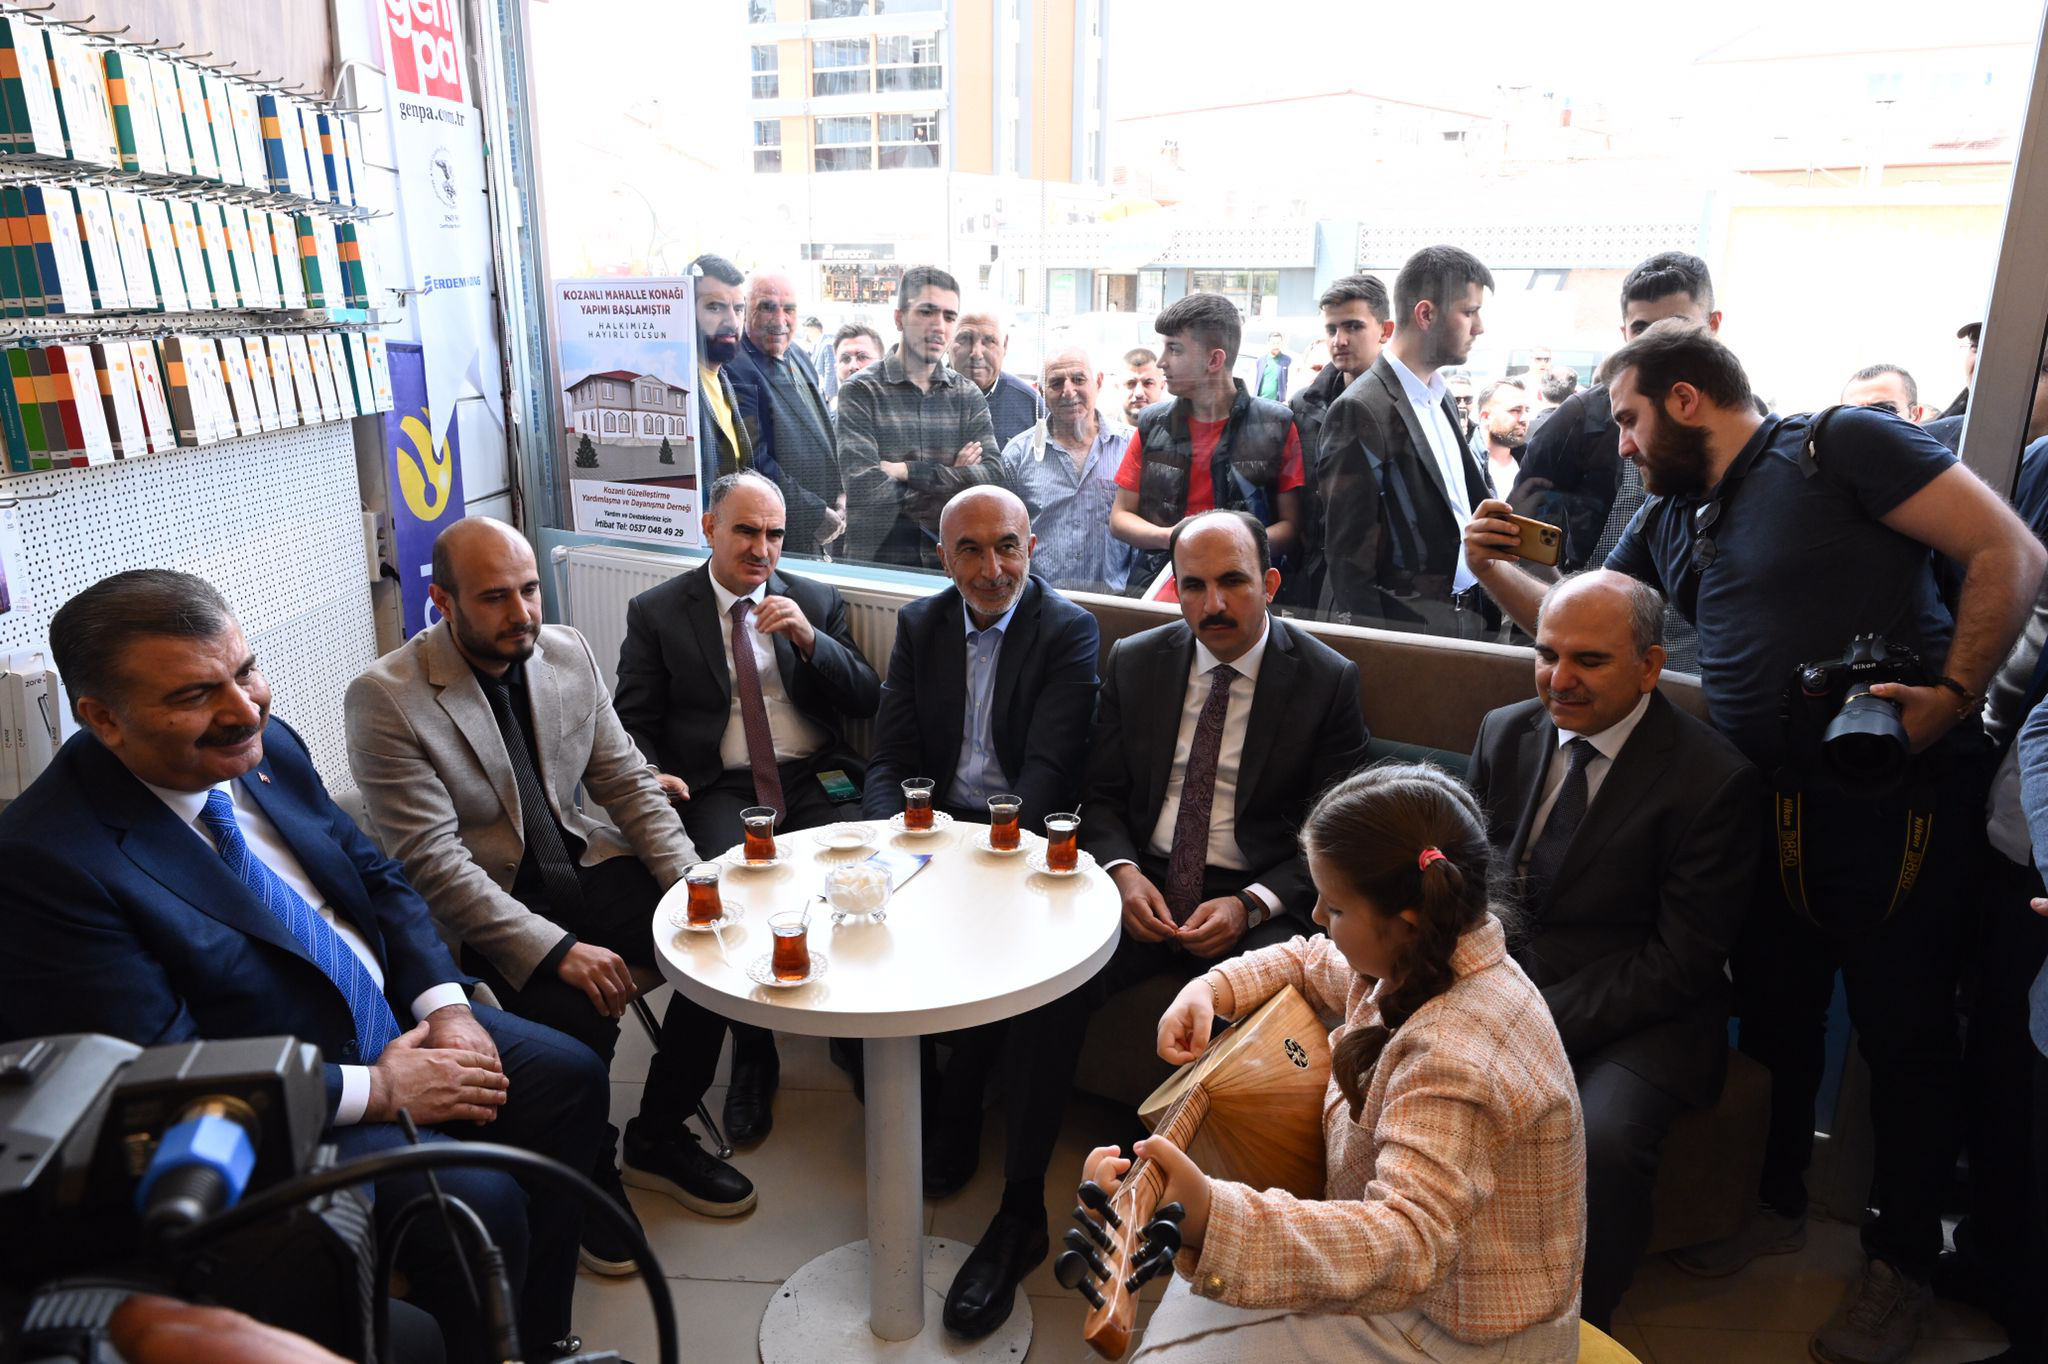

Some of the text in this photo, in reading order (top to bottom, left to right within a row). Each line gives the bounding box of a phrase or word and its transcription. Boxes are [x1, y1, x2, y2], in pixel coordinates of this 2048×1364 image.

[411, 29, 458, 95] pa
[433, 277, 467, 289] ERDEM
[563, 286, 684, 300] KOZANLI MAHALLE KONAĞI
[580, 304, 671, 316] YAPIMI BAŞLAMIŞTIR
[598, 322, 655, 330] HALKIMIZA
[588, 331, 667, 339] HAYIRLI OLSUN
[603, 486, 670, 500] Kozanlı Güzelleştirme
[582, 494, 621, 505] Yardımlaşma
[631, 499, 665, 510] Dayanışma
[666, 502, 692, 513] Derneği
[616, 522, 628, 531] Tel:
[629, 523, 646, 533] 0537
[648, 525, 662, 534] 048
[663, 527, 673, 536] 49
[674, 528, 684, 537] 29
[1852, 662, 1877, 670] Nikon
[25, 678, 42, 688] zore
[1781, 798, 1798, 867] Nikon D850
[1901, 816, 1924, 890] Nikon D850
